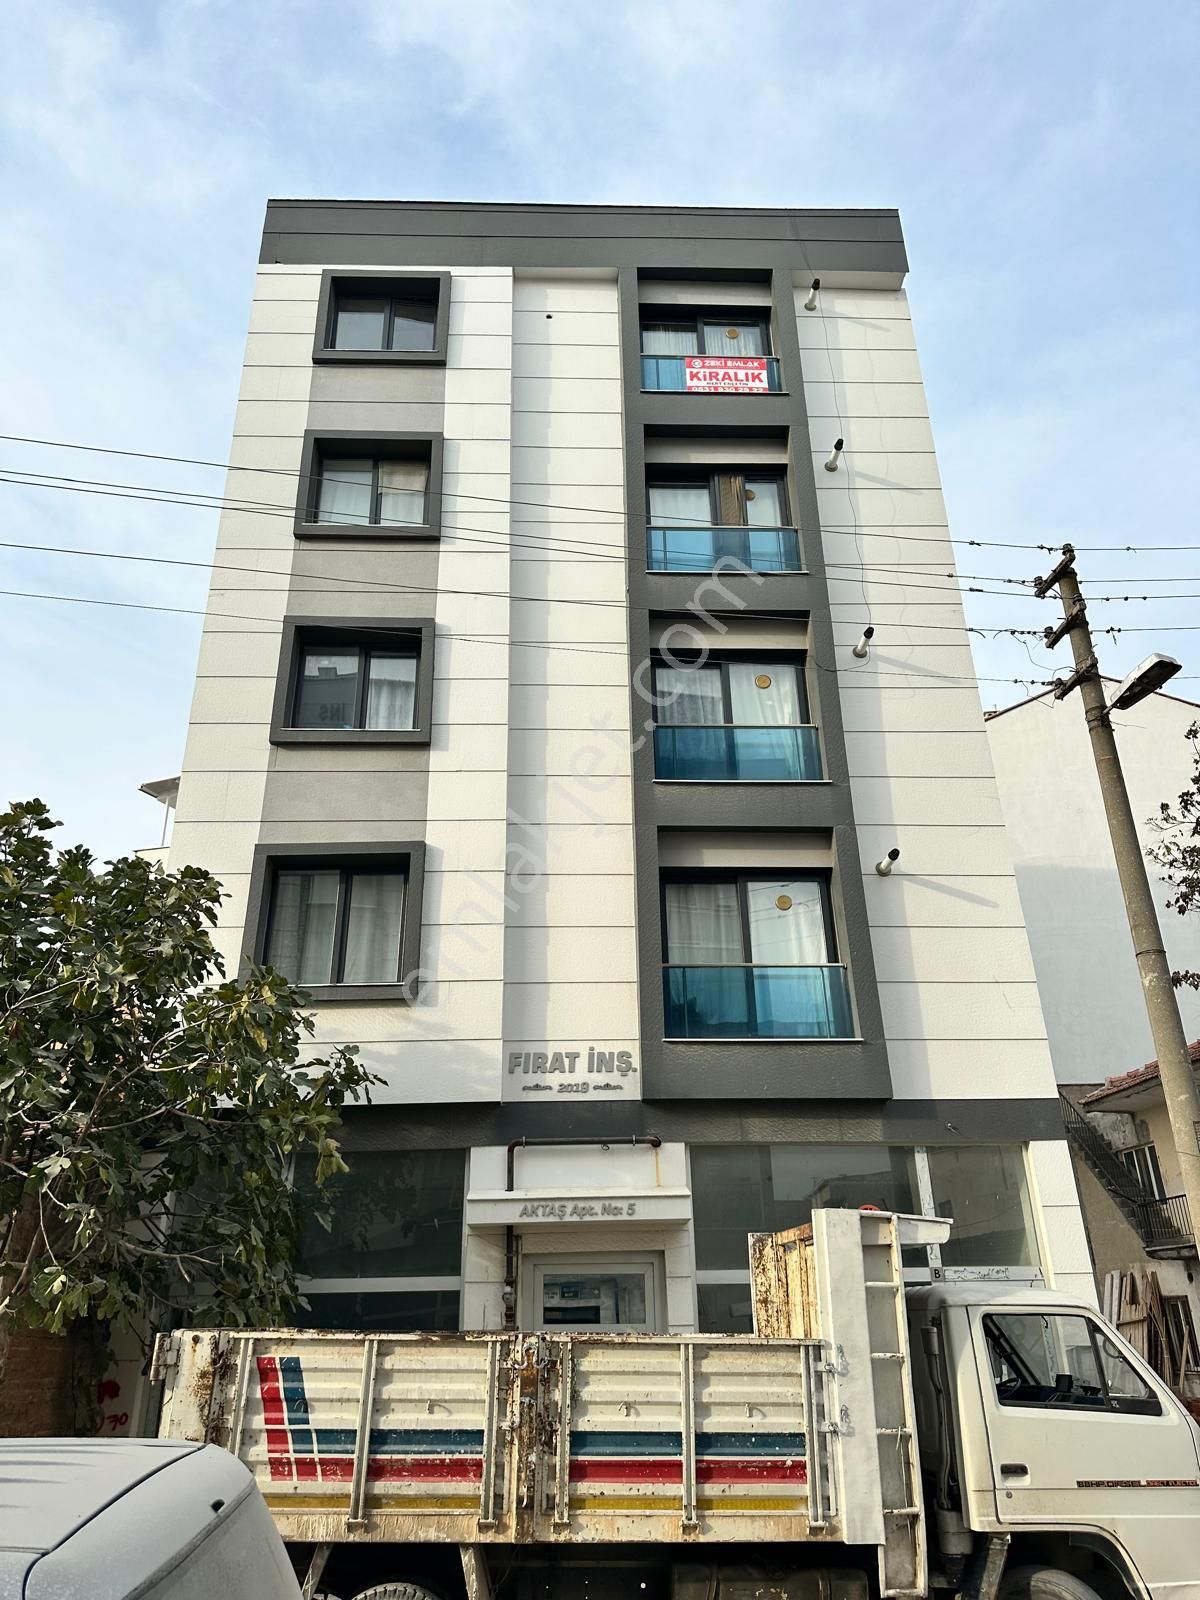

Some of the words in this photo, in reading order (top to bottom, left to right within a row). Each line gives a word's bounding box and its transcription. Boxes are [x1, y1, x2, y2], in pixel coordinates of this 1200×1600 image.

[727, 360, 760, 368] EMLAK
[508, 1051, 580, 1075] FIRAT
[587, 1046, 638, 1077] İNŞ.
[557, 1082, 590, 1094] 2019
[519, 1203, 567, 1221] AKTAŞ
[569, 1203, 599, 1220] Apt.
[626, 1202, 637, 1217] 5
